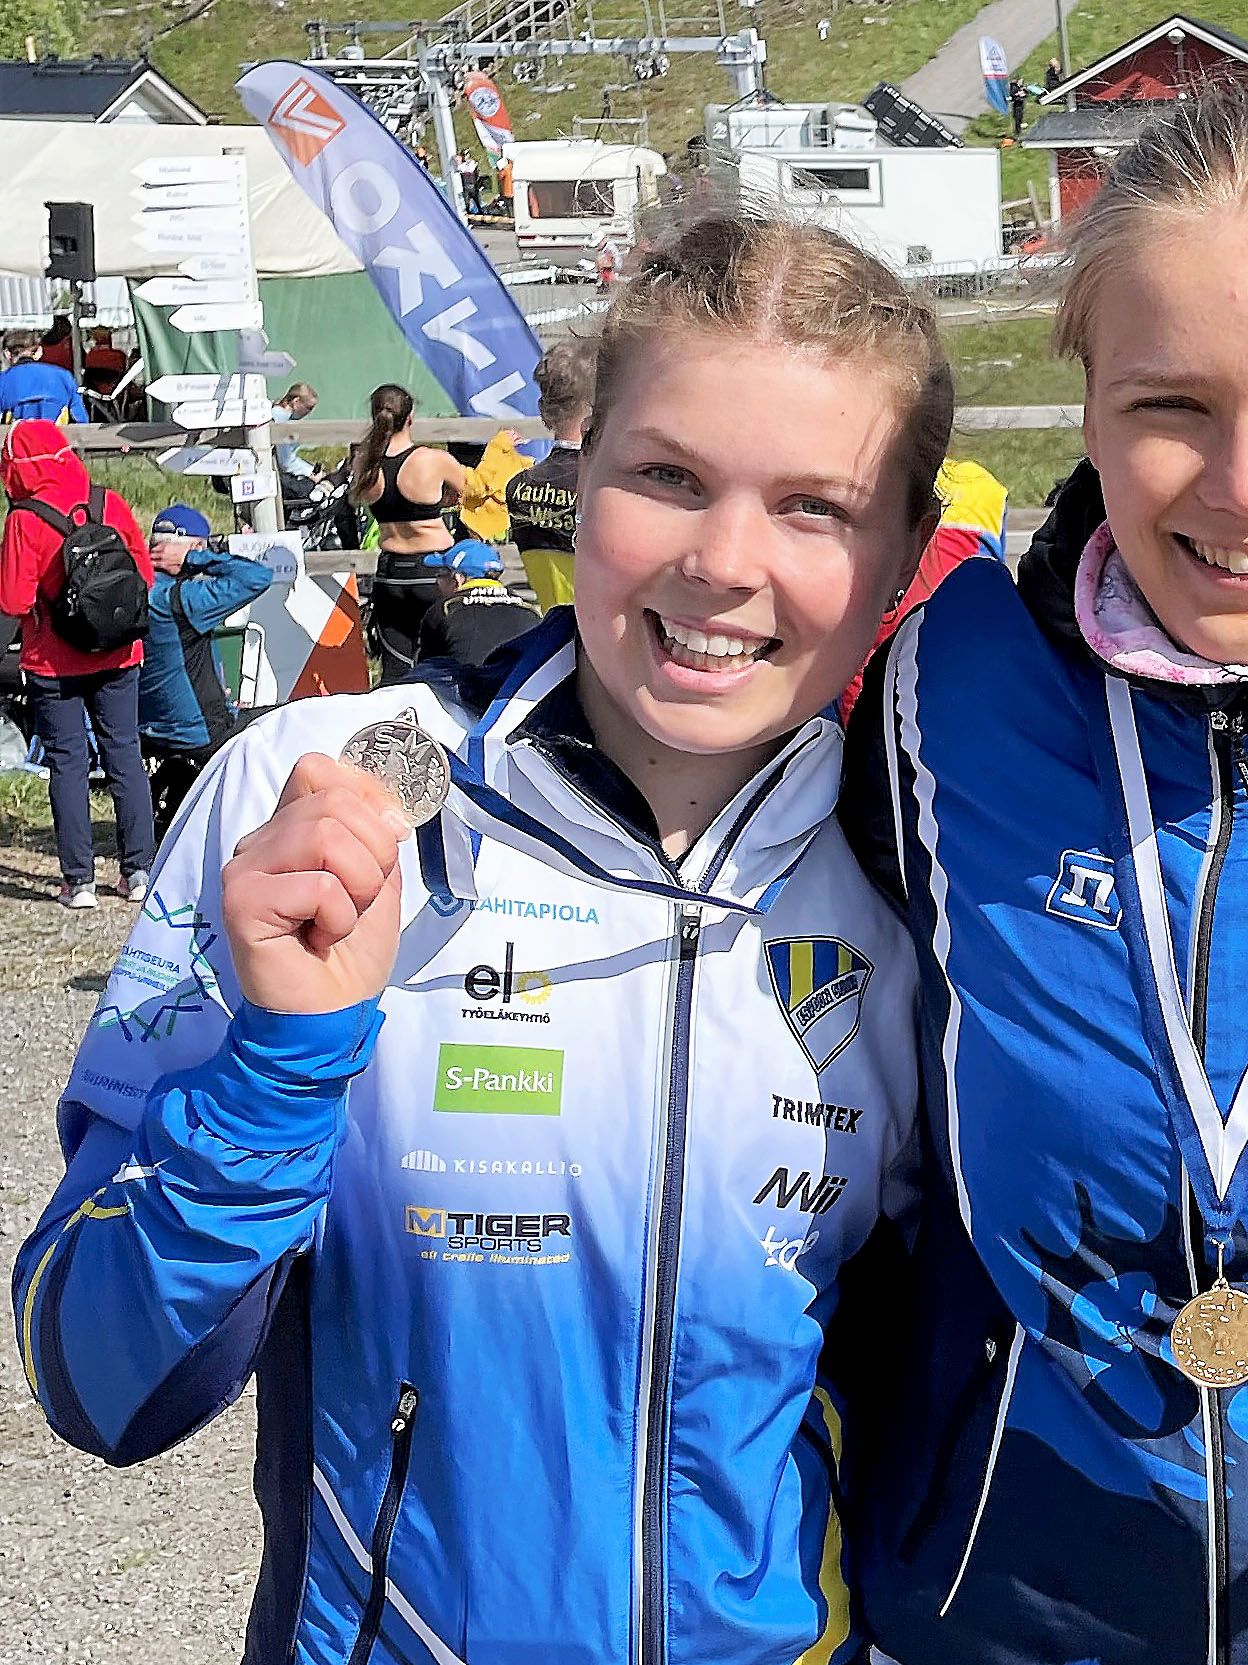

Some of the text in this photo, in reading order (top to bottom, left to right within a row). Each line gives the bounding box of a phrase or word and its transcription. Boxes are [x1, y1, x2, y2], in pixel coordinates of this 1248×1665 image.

[464, 941, 553, 1005] elo
[444, 1066, 553, 1093] S-Pankki
[772, 1093, 864, 1135] TRIMTEX
[454, 1159, 582, 1178] KISAKALLIO
[447, 1212, 571, 1238] TIGER
[448, 1236, 542, 1253] SPORTS
